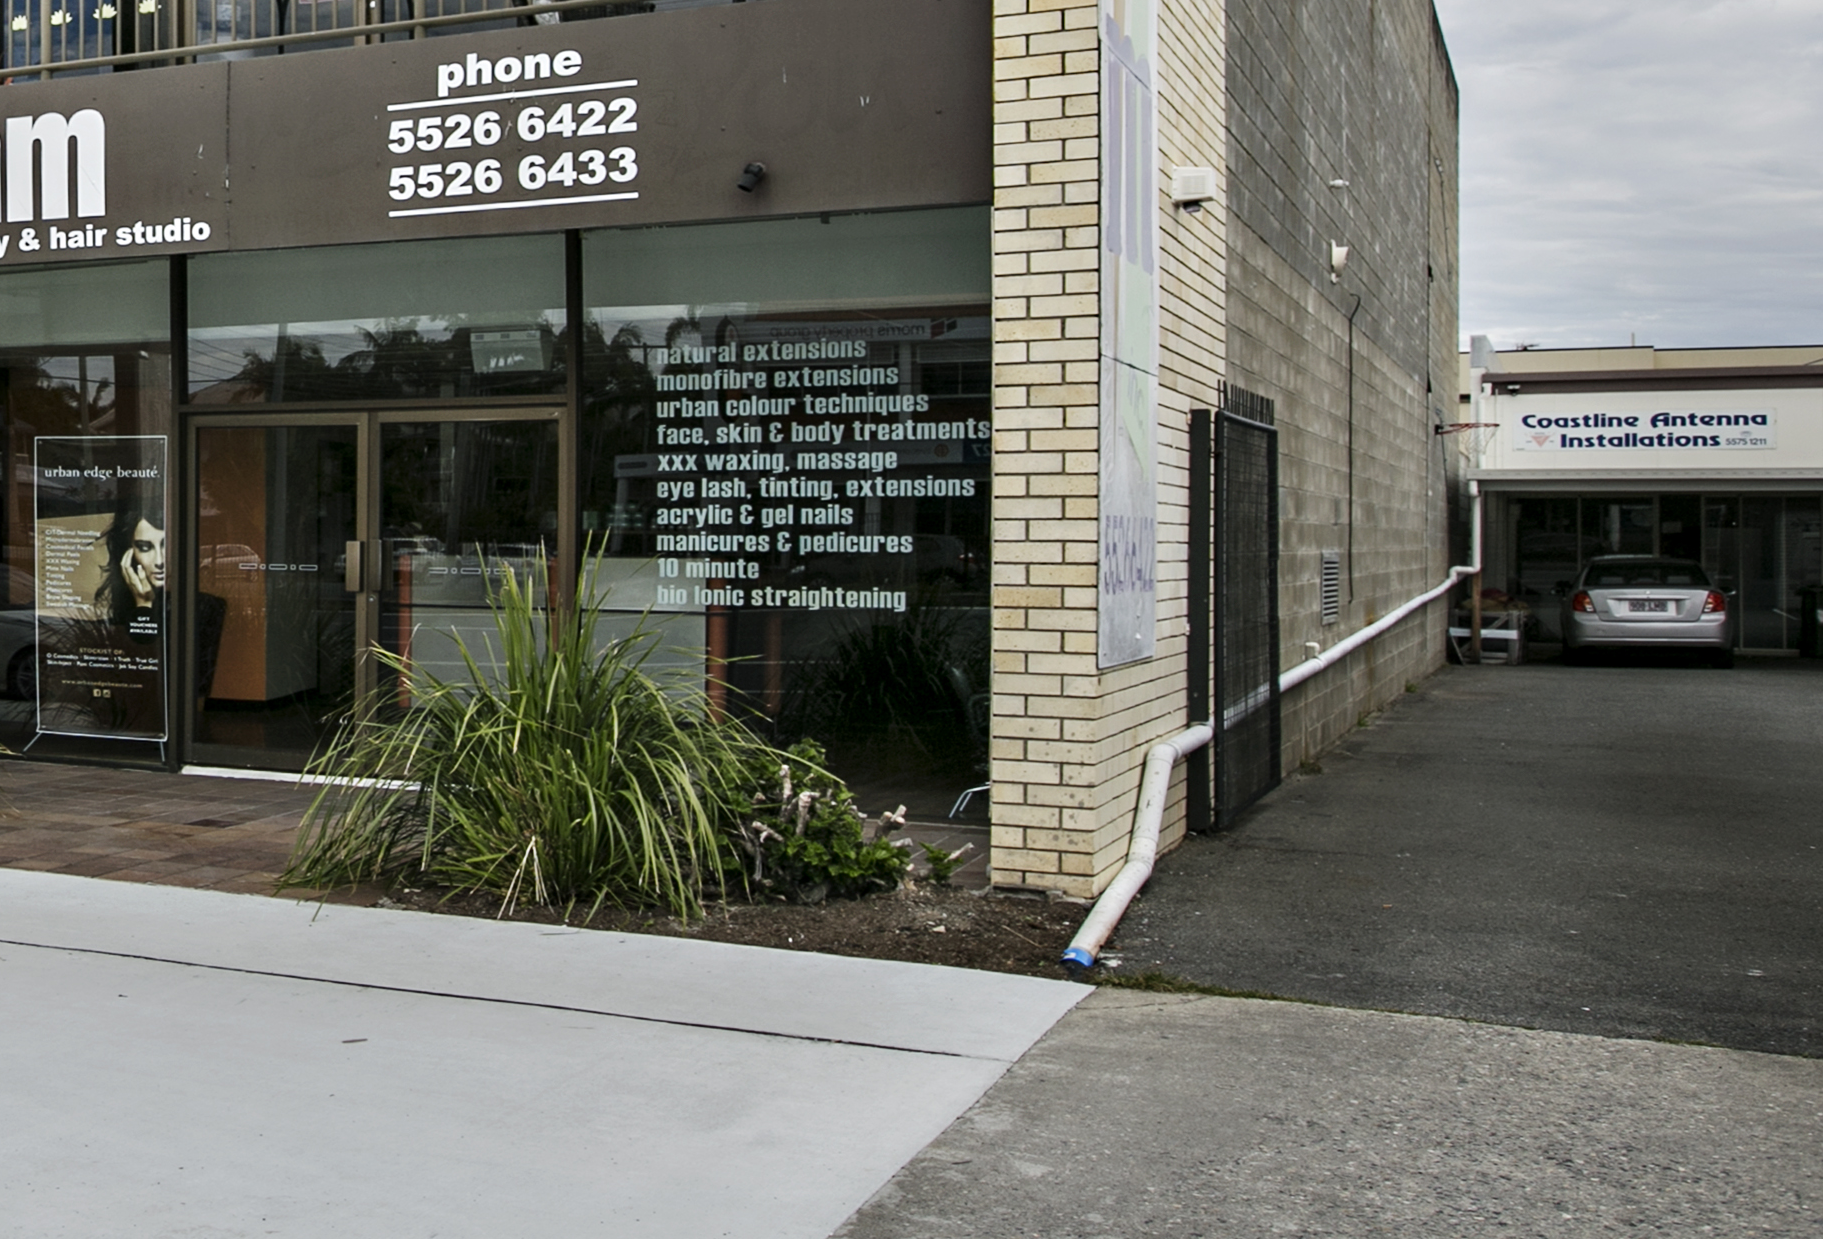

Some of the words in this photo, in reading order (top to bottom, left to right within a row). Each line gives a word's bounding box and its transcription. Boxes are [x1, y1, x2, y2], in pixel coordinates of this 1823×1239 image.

[438, 50, 583, 98] phone
[388, 110, 502, 155] 5526
[517, 96, 639, 144] 6422
[388, 159, 502, 202] 5526
[517, 145, 640, 192] 6433
[19, 226, 40, 251] &
[49, 222, 108, 250] hair
[115, 216, 211, 245] studio
[656, 343, 738, 365] natural
[743, 338, 866, 362] extensions
[656, 369, 767, 392] monofibre
[774, 367, 899, 388] extensions
[656, 399, 719, 419] urban
[726, 395, 796, 417] colour
[804, 393, 929, 417] techniques
[657, 424, 710, 447] face,
[717, 422, 763, 444] skin
[769, 423, 784, 443] &
[791, 421, 845, 446] body
[853, 418, 991, 441] treatments
[1522, 413, 1640, 429] Coastline
[1650, 412, 1768, 429] Antenna
[1560, 432, 1721, 449] Installations
[44, 465, 81, 478] urban
[83, 465, 114, 481] edge
[116, 464, 161, 479] beauté.
[657, 455, 698, 472] xxx
[705, 451, 791, 474] waxing,
[797, 450, 898, 472] massage
[656, 480, 695, 501] eye
[701, 478, 752, 500] lash,
[759, 478, 839, 501] tinting,
[846, 475, 976, 498] extensions
[656, 504, 733, 529] acrylic
[739, 505, 755, 525] &
[761, 504, 794, 529] gel
[800, 504, 854, 526] nails
[656, 532, 770, 552] manicures
[776, 533, 792, 553] &
[799, 531, 914, 556] pedicures
[657, 558, 679, 579] 10
[685, 558, 760, 579] minute
[656, 585, 687, 606] bio
[750, 586, 907, 612] straightening
